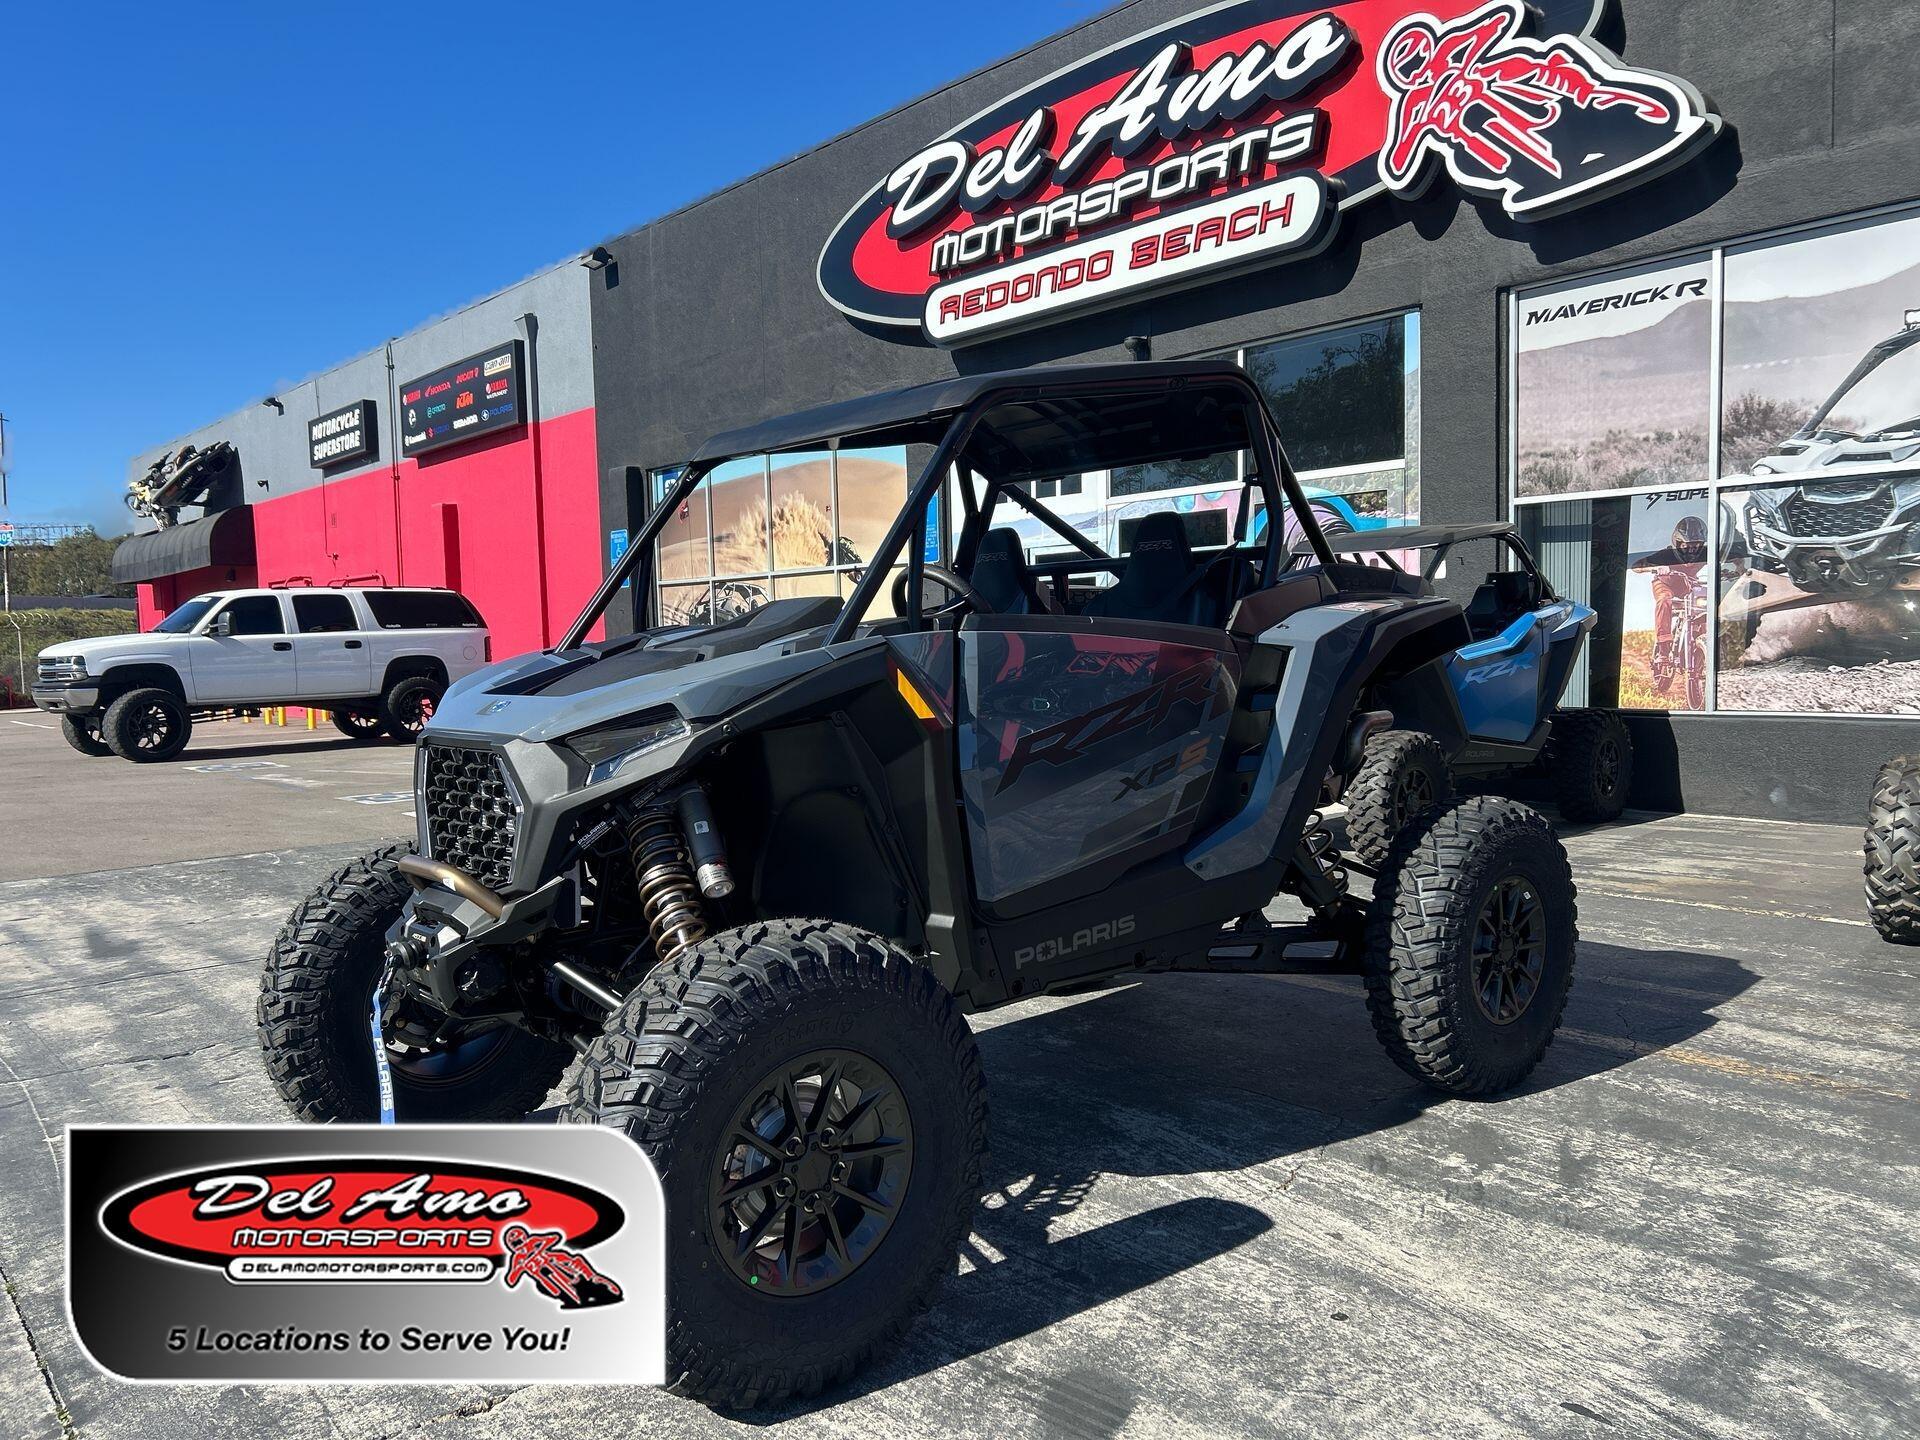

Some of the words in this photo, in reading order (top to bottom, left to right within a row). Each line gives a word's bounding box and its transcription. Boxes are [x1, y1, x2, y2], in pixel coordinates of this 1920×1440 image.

[887, 106, 1048, 227] Del
[1059, 16, 1350, 171] Amo
[930, 112, 1316, 274] MOTORSPORTS
[940, 249, 1113, 325] REDONDO
[1129, 193, 1294, 271] BEACH
[1526, 284, 1673, 326] MAVERICK
[1675, 278, 1707, 297] R
[312, 409, 360, 441] MOTORCYCLE
[456, 391, 474, 409] KTM
[490, 403, 513, 416] POLARIS
[313, 430, 360, 461] SUPERSTORE
[994, 658, 1221, 797] RZR
[1015, 914, 1136, 970] POLARIS
[373, 1037, 393, 1111] POLARIS
